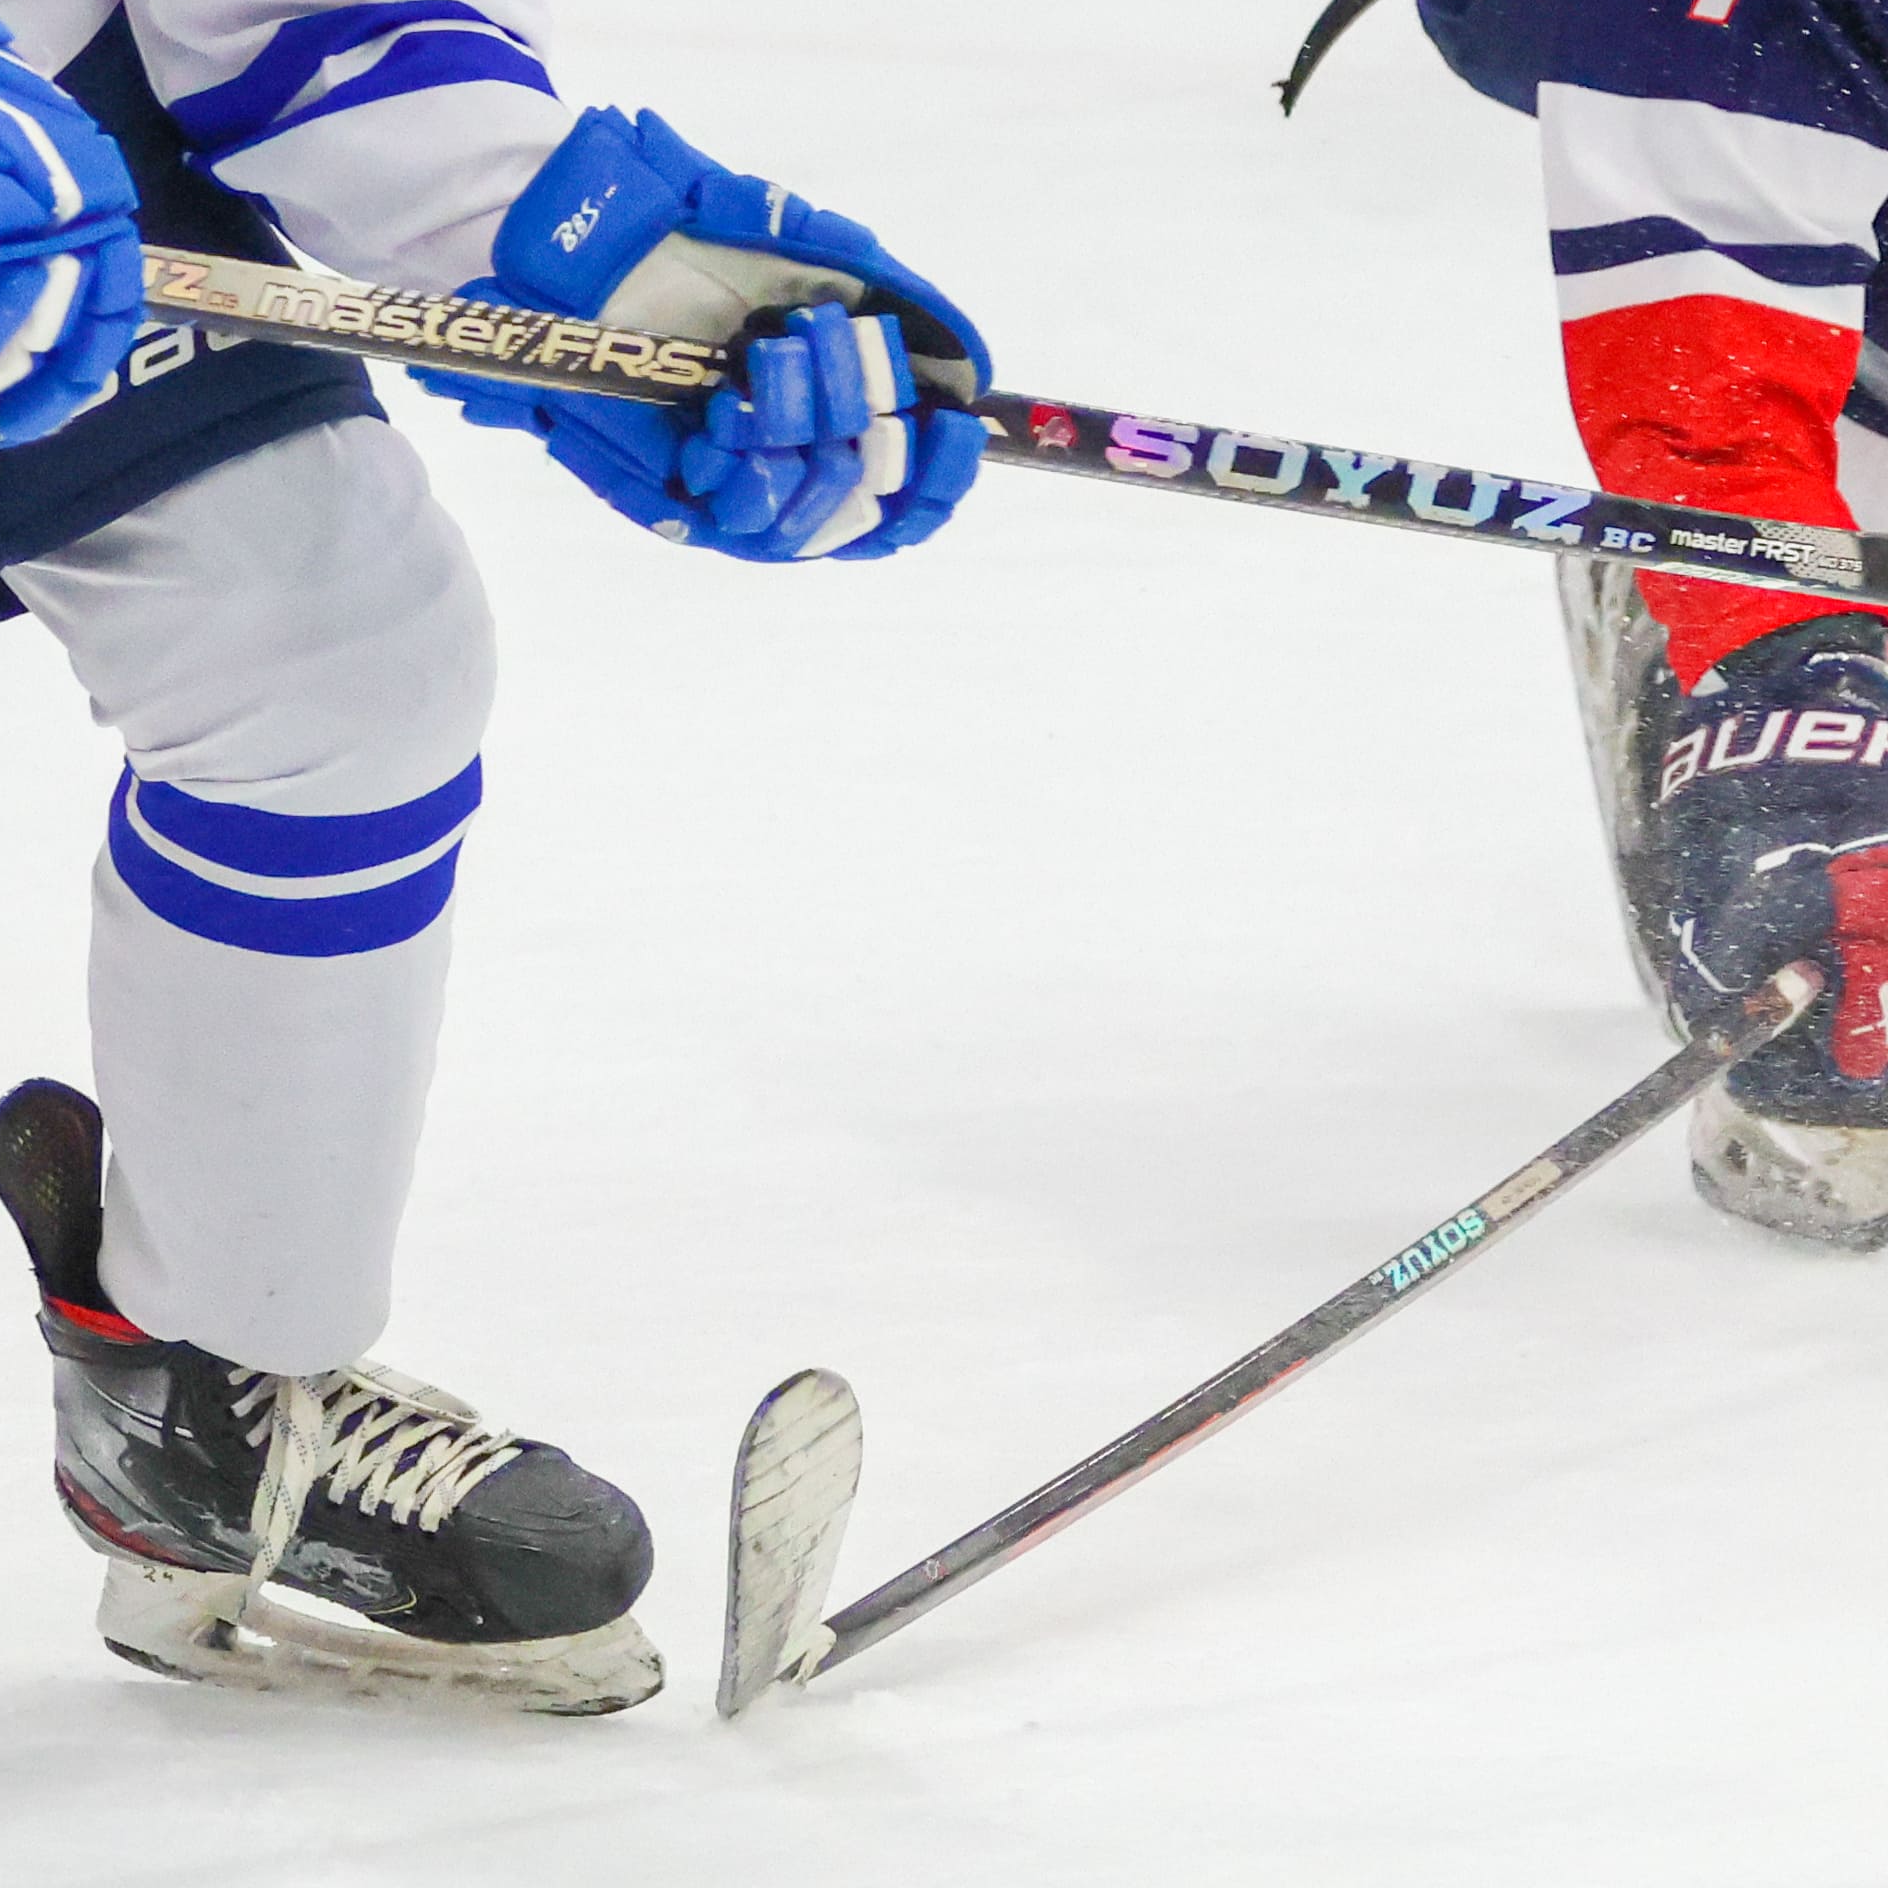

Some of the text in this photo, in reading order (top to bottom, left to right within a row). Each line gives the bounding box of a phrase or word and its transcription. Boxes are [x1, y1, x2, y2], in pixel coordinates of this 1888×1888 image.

[540, 321, 726, 387] FRS
[1104, 414, 1656, 553] SOYUZ BC
[1669, 528, 1749, 557] master
[1750, 537, 1816, 564] FRST
[1382, 1208, 1486, 1292] SOYUZ
